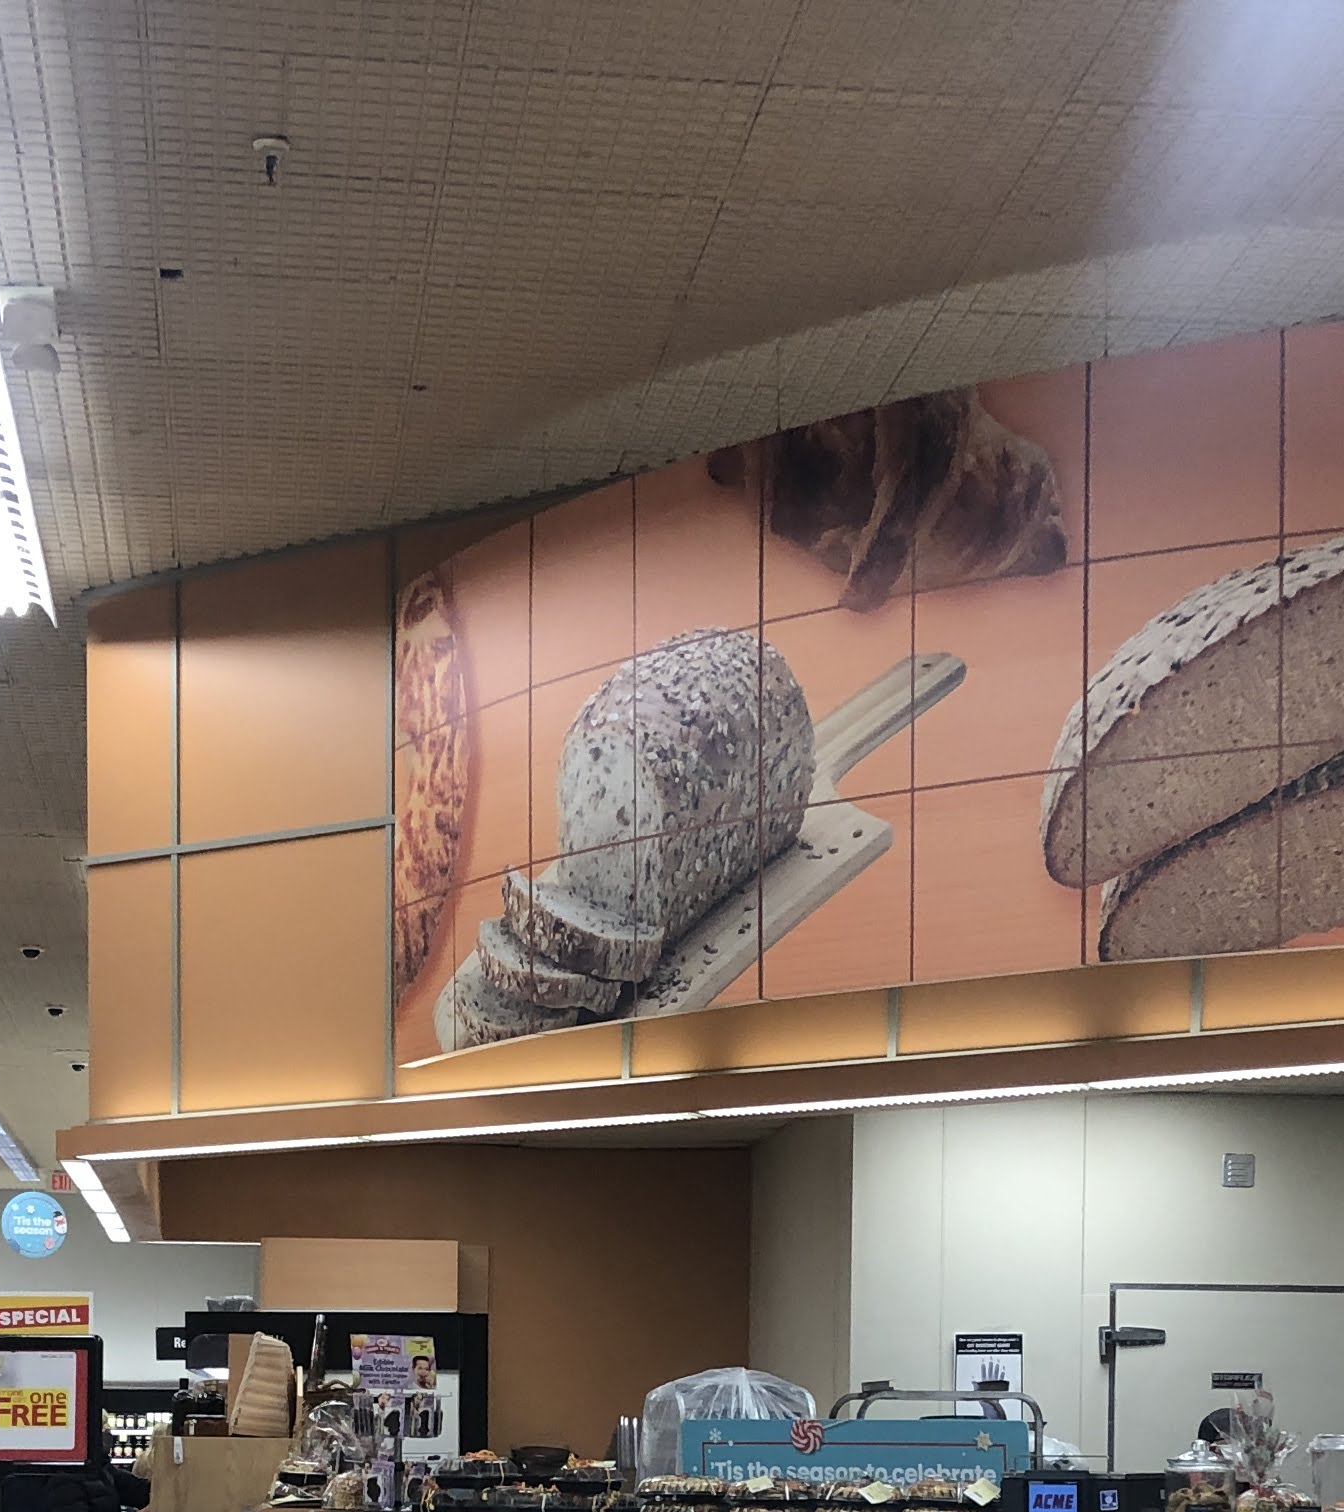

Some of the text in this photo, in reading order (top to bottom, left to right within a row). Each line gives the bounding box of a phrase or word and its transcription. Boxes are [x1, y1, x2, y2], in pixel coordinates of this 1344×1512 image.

[32, 1216, 52, 1227] the
[13, 1226, 53, 1236] season
[0, 1309, 81, 1326] SPECIAL
[29, 1392, 67, 1405] one
[711, 1460, 743, 1481] 'Tis
[786, 1465, 861, 1482] season
[866, 1463, 886, 1479] to
[892, 1463, 997, 1483] celebrate
[1032, 1493, 1075, 1510] ACME
